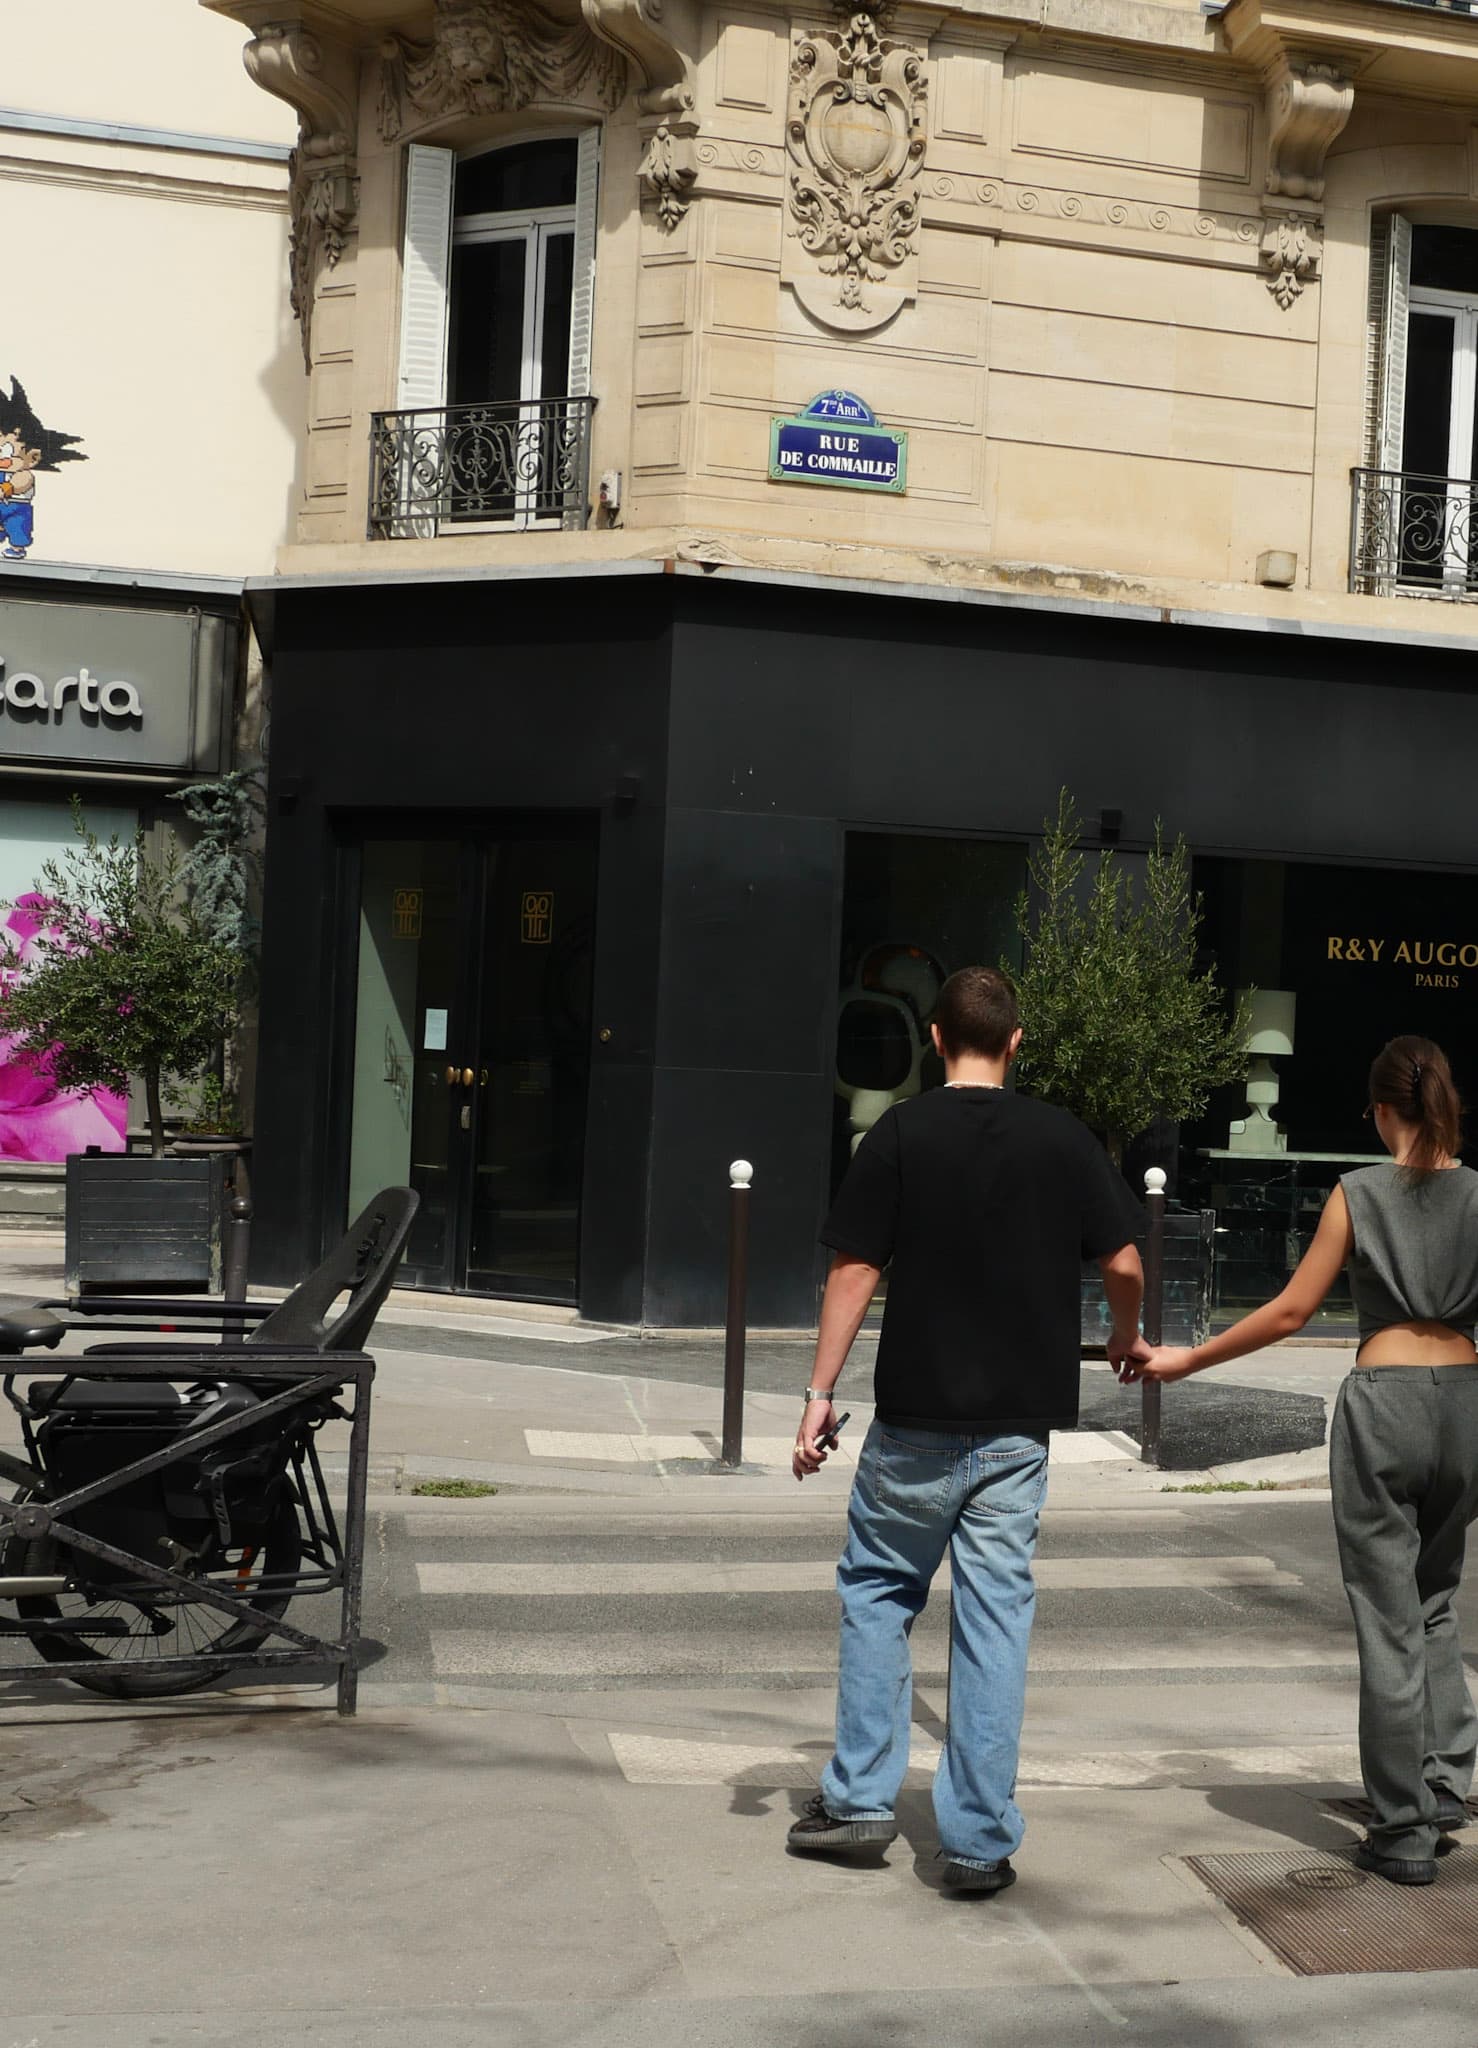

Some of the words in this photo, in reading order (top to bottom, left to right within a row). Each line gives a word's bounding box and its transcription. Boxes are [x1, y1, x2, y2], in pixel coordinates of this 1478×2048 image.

[819, 434, 860, 453] RUE
[780, 450, 803, 467] DE
[807, 453, 897, 477] COMMAILLE
[0, 657, 143, 716] arta
[1327, 936, 1385, 962] R&Y
[1393, 941, 1478, 967] AUGO
[1415, 973, 1460, 988] PARIS
